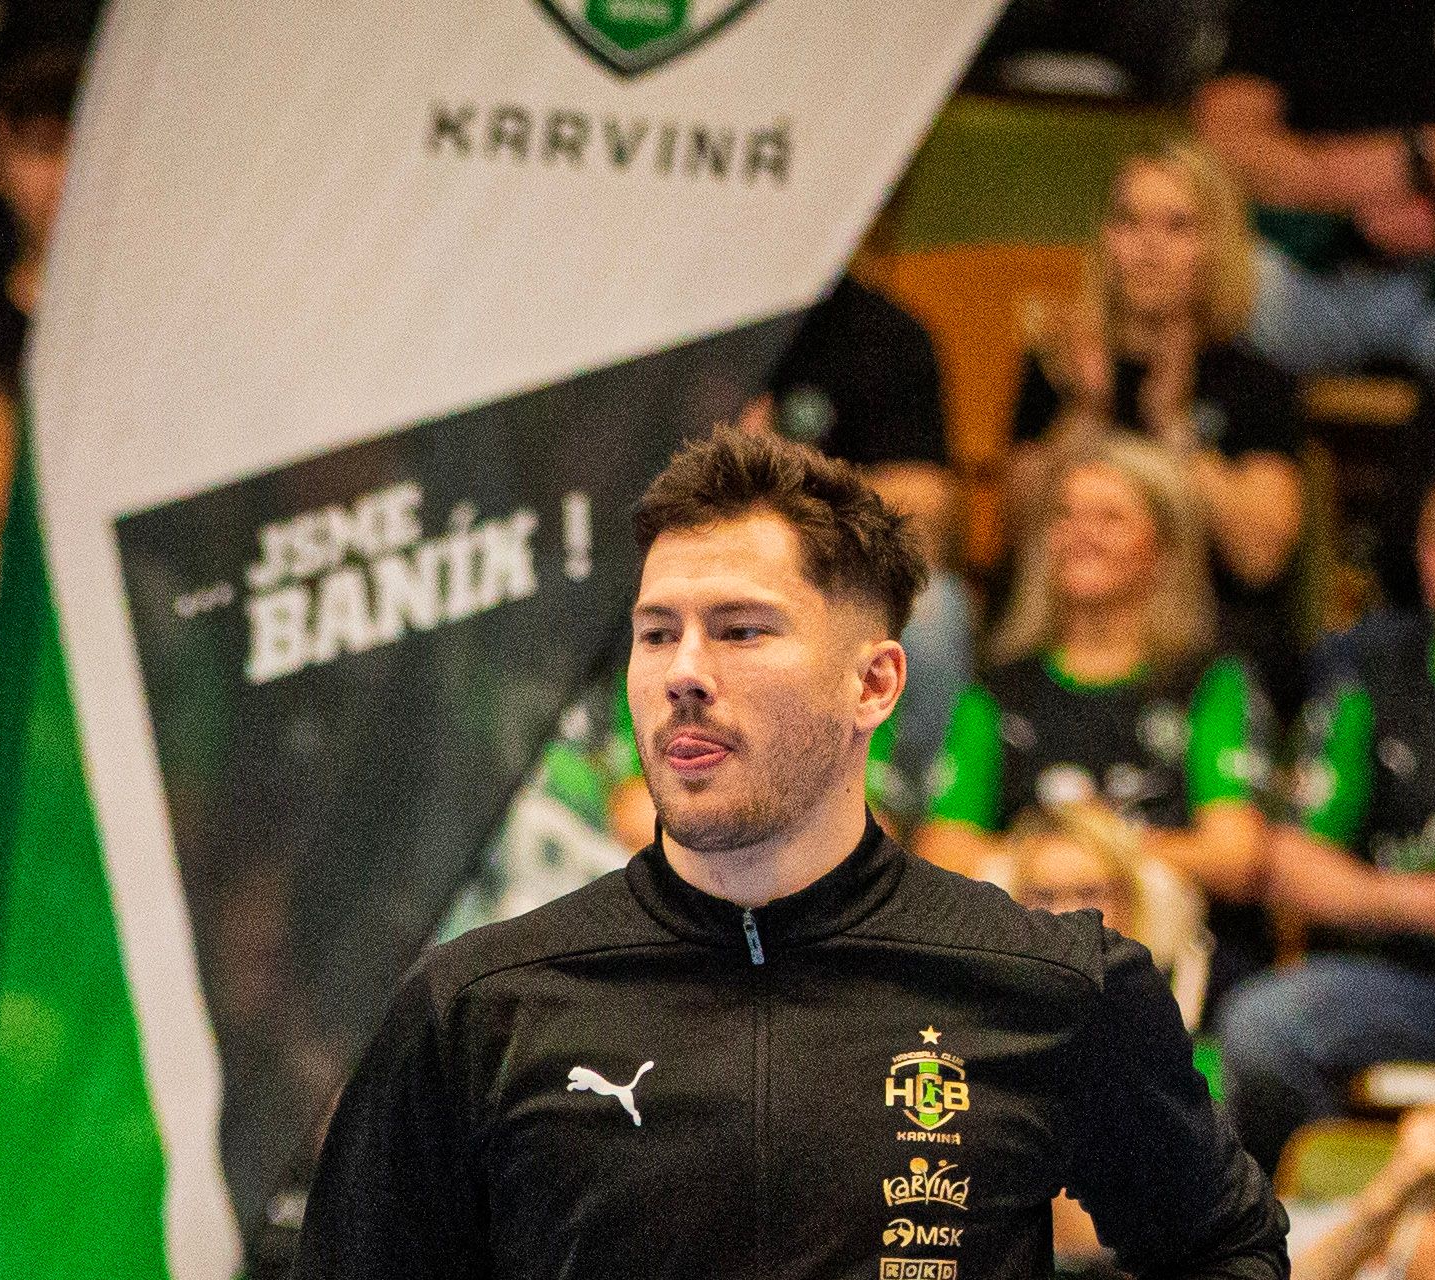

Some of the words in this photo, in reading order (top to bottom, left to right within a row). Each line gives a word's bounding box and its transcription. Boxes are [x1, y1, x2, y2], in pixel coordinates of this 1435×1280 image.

[428, 103, 794, 187] KARVINÁ
[248, 483, 425, 588] JSME
[245, 503, 539, 684] BANÍK
[885, 1073, 970, 1114] HCB
[897, 1132, 961, 1145] KARVINÁ
[917, 1226, 963, 1247] MSK
